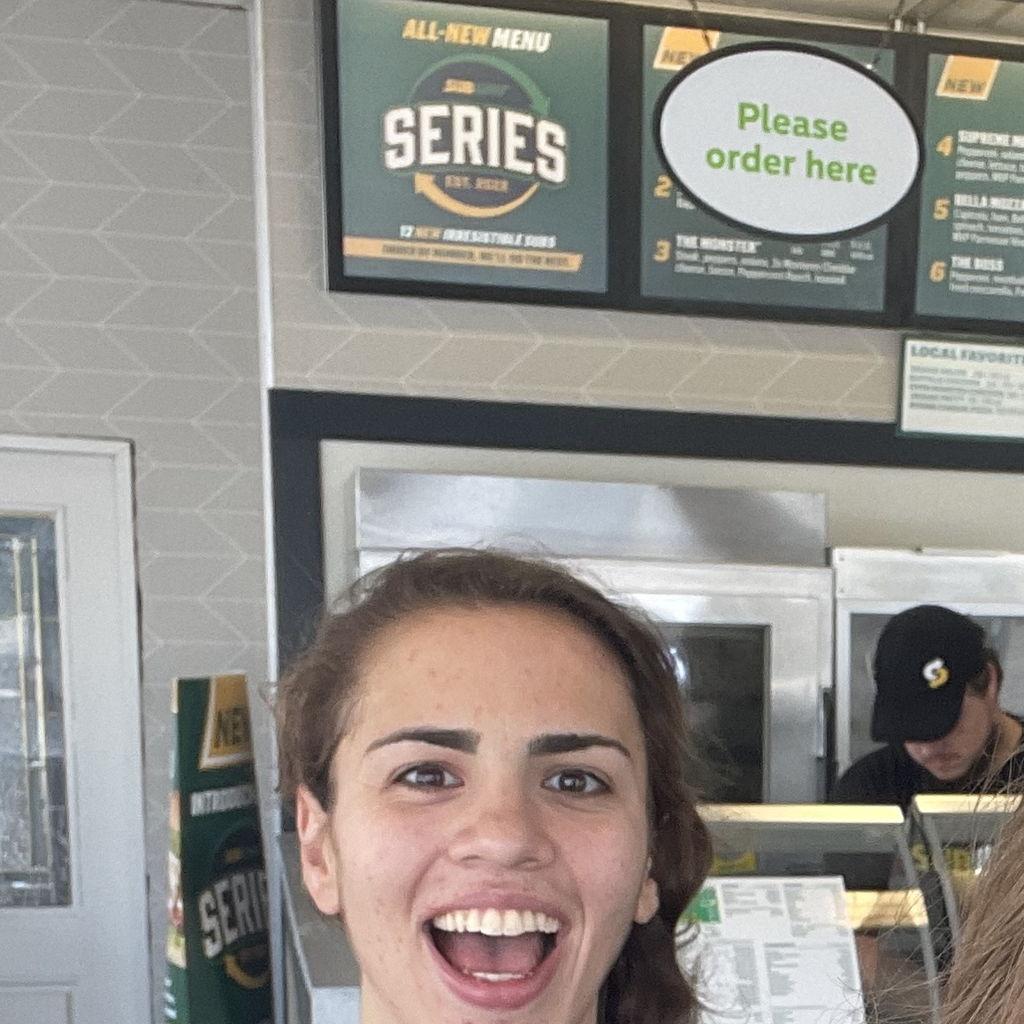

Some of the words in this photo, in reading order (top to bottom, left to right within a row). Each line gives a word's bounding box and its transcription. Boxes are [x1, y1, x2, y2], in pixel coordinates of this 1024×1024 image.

[402, 18, 492, 46] ALL-NEW
[491, 27, 552, 53] MENU
[660, 48, 698, 65] NE
[945, 78, 987, 93] NEW
[737, 101, 849, 142] Please
[383, 104, 568, 184] SERIES
[936, 136, 953, 158] 4
[705, 142, 797, 177] order
[805, 151, 878, 186] here
[654, 175, 673, 198] 2
[933, 198, 951, 221] 5
[654, 240, 671, 262] 3
[929, 260, 947, 283] 6
[911, 345, 957, 361] LOCAL
[213, 706, 251, 750] NE
